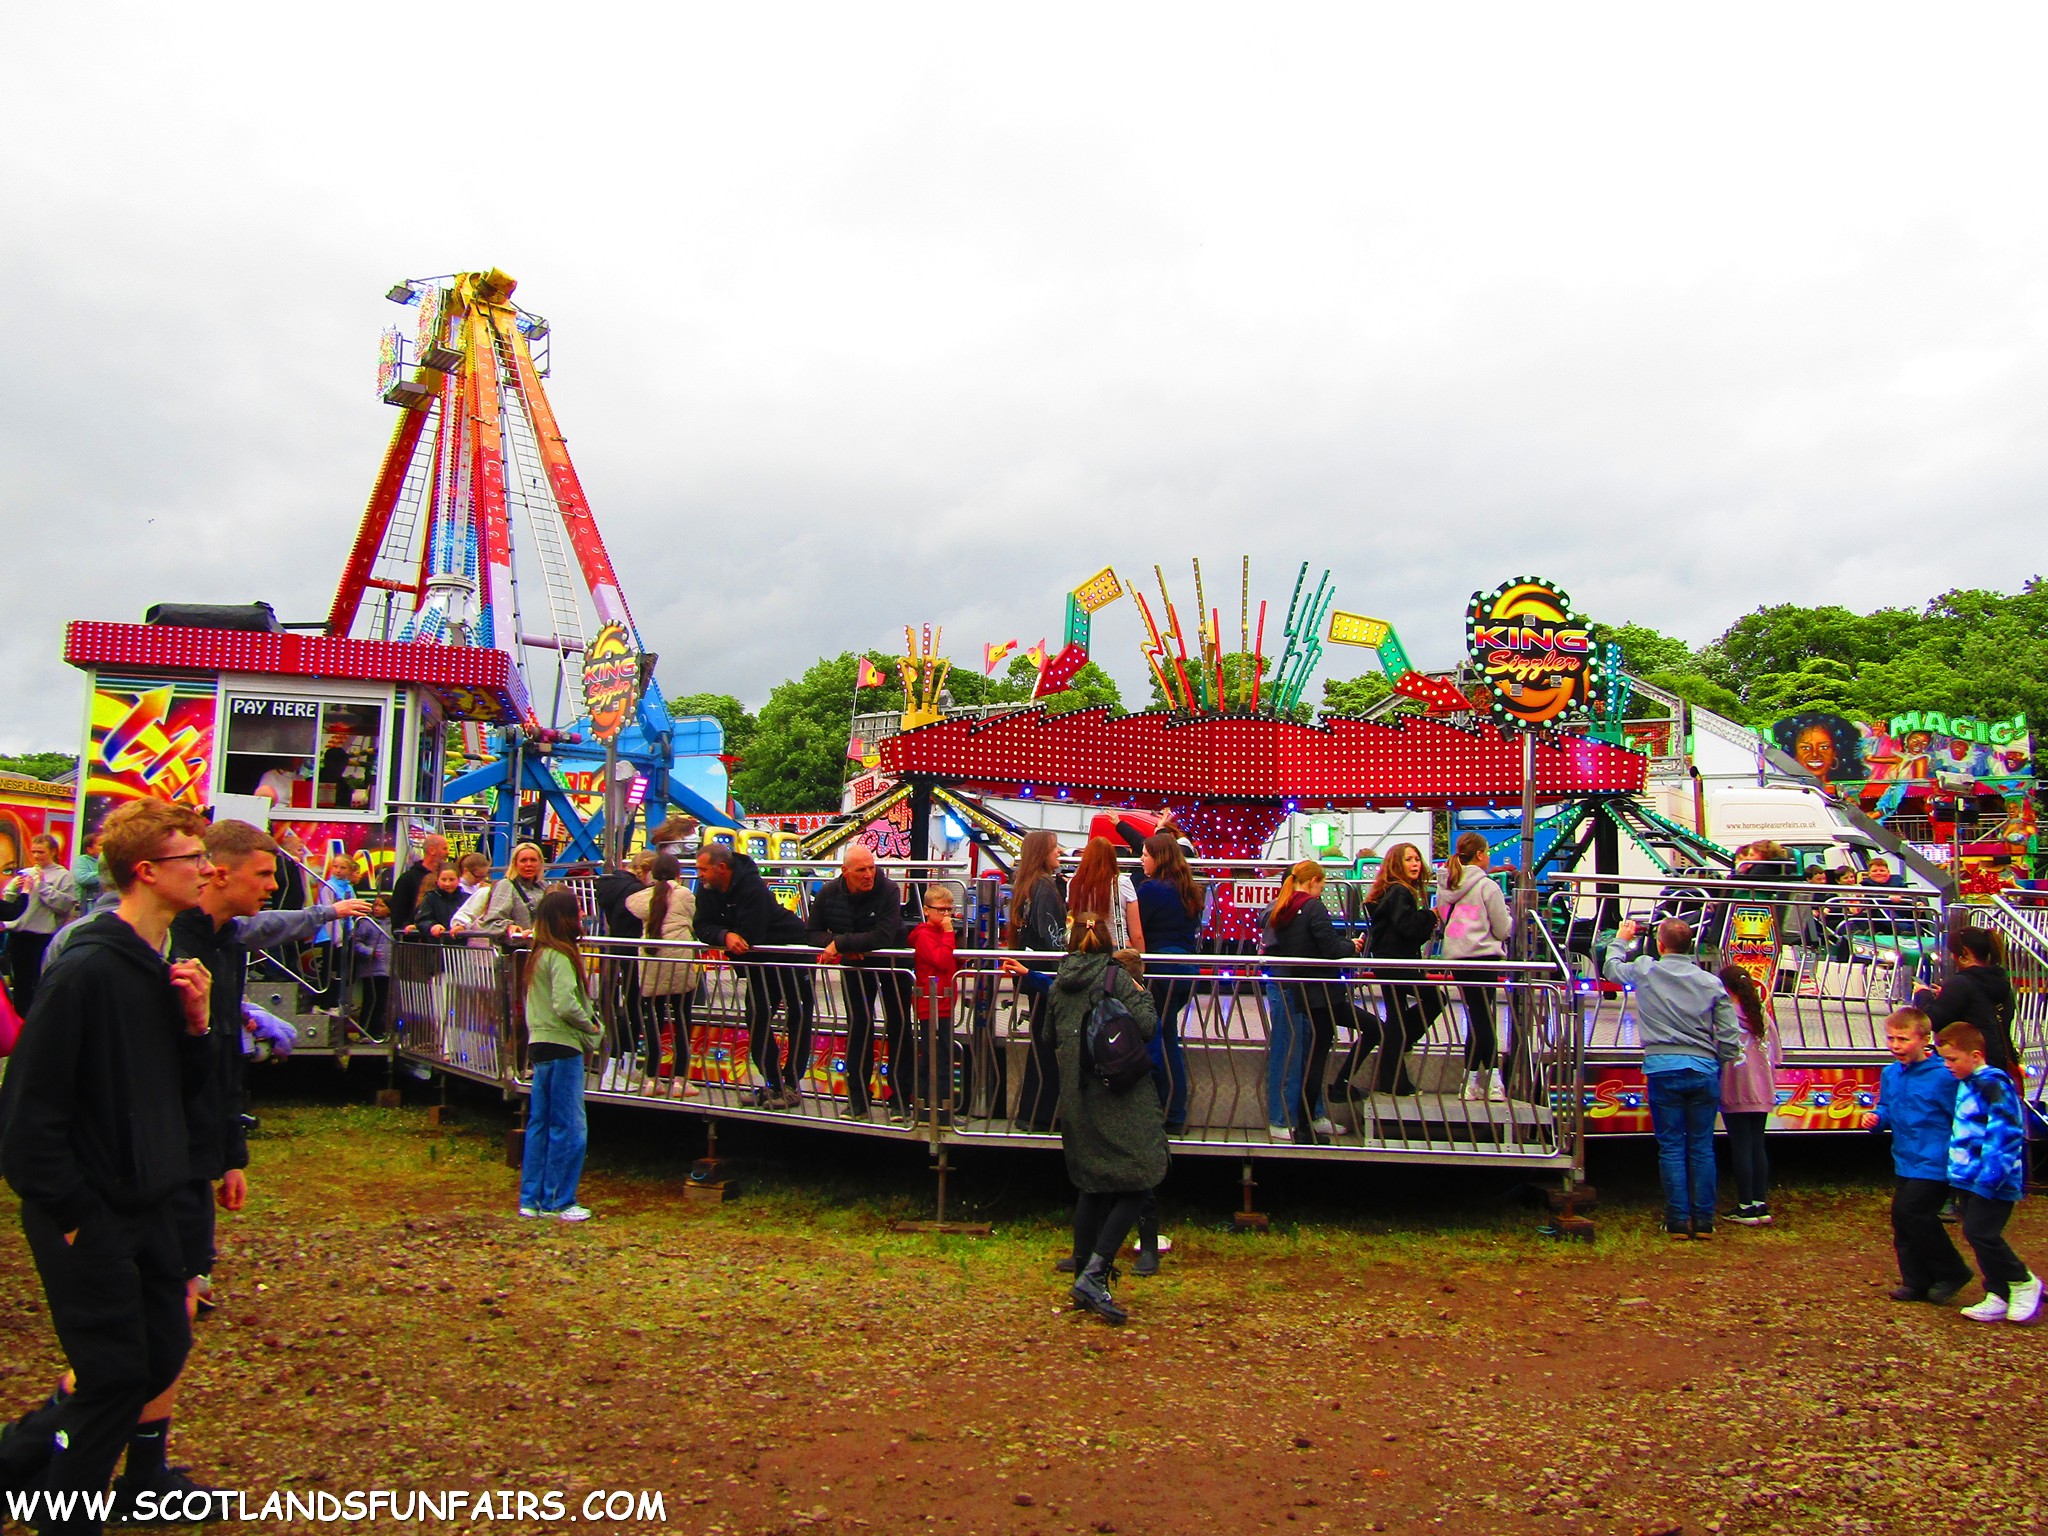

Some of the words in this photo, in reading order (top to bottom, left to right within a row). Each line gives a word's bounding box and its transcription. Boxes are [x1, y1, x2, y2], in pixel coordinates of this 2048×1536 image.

[1474, 625, 1589, 653] KING
[584, 656, 637, 685] KING
[1484, 649, 1580, 681] Sizzler
[587, 678, 631, 707] Sizzler
[233, 699, 267, 715] PAY
[272, 701, 316, 718] HERE
[1888, 709, 2028, 745] MAGIC!
[1726, 820, 1816, 830] www.hornespleasurefairs.co.uk
[1729, 940, 1775, 955] KING
